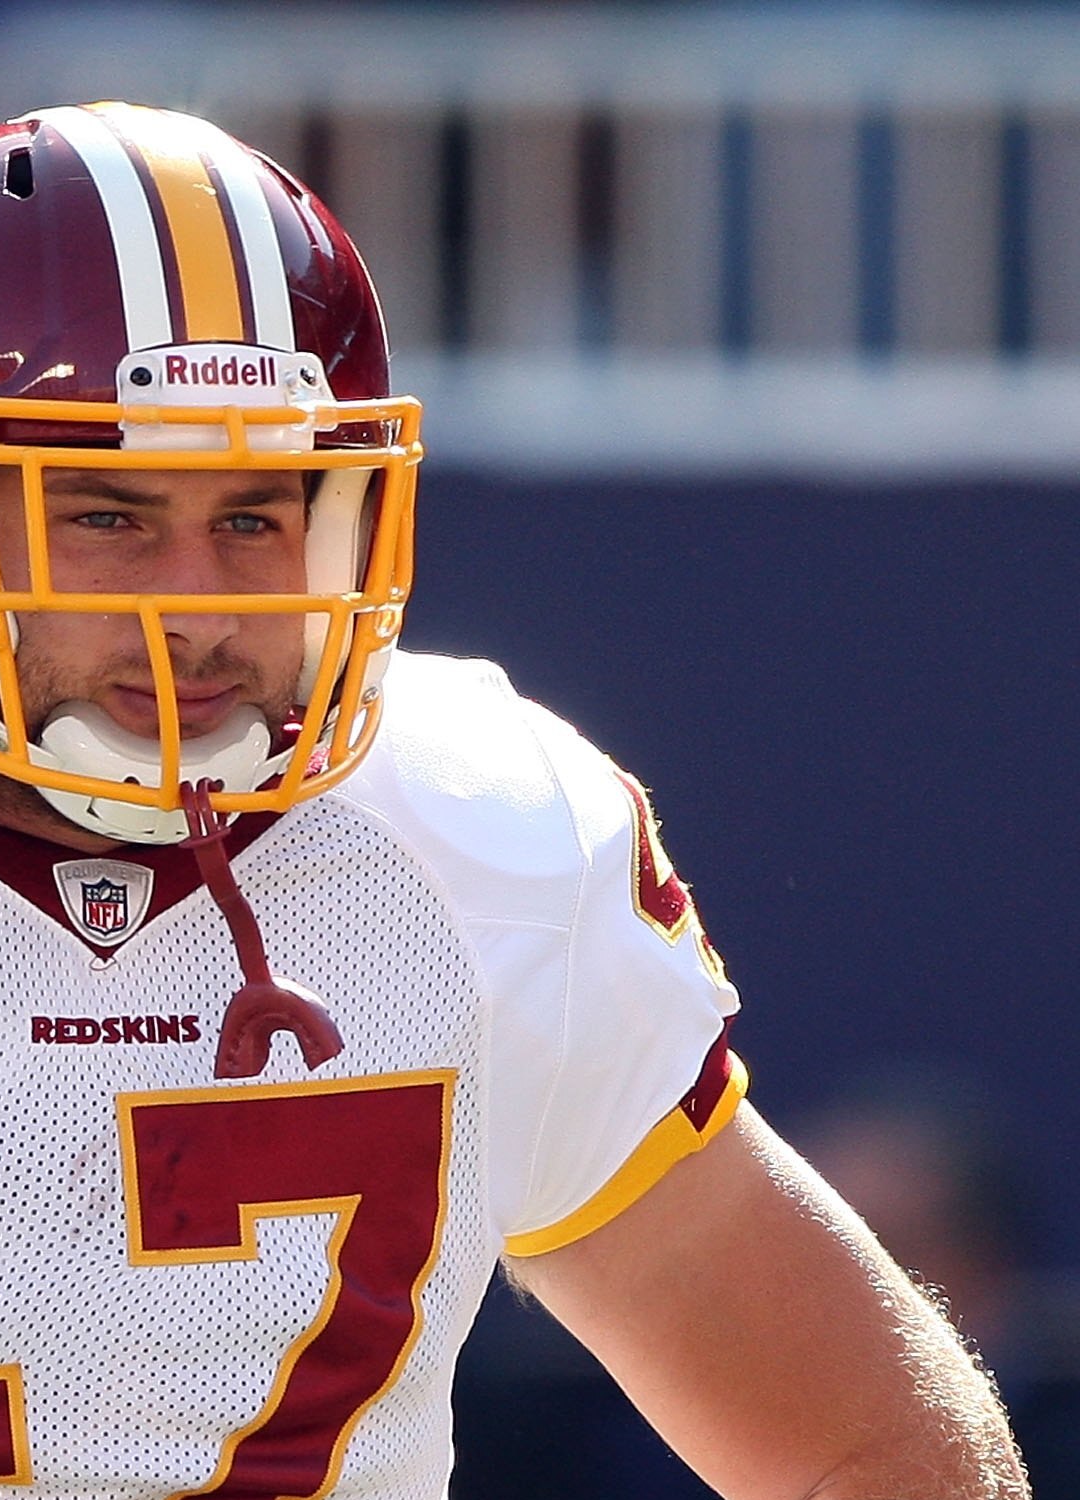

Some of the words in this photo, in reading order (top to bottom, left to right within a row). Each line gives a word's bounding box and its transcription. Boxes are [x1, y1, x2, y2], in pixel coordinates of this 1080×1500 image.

[165, 355, 276, 387] Riddell
[86, 901, 126, 929] NFL
[31, 1016, 202, 1044] REDSKINS
